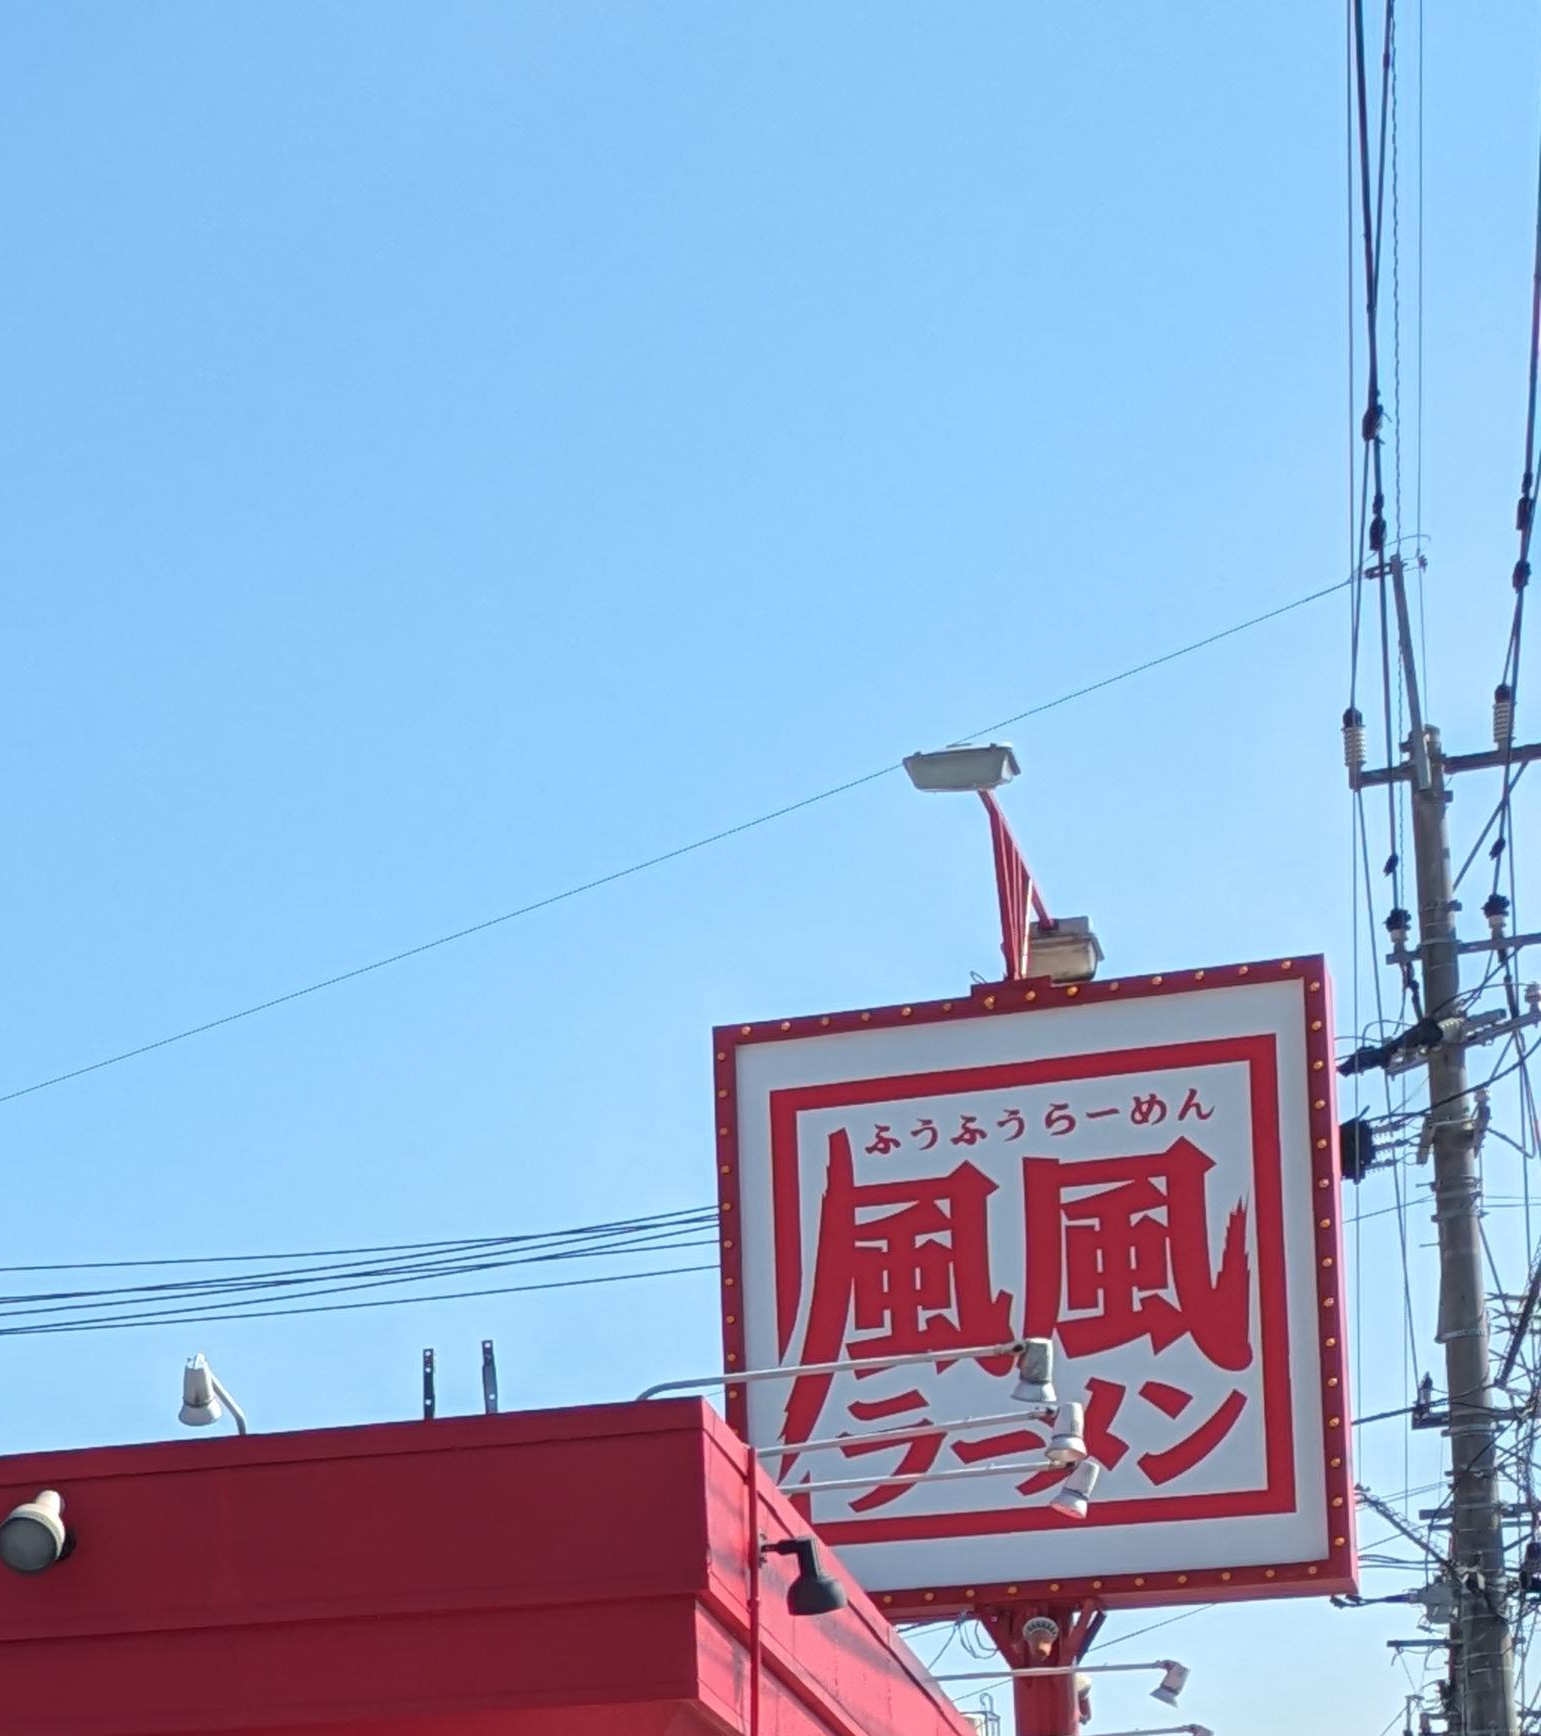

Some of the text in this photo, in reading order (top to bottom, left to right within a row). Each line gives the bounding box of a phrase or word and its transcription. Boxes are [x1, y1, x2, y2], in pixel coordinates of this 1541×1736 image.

[863, 1087, 1216, 1155] ふうふうらーめん
